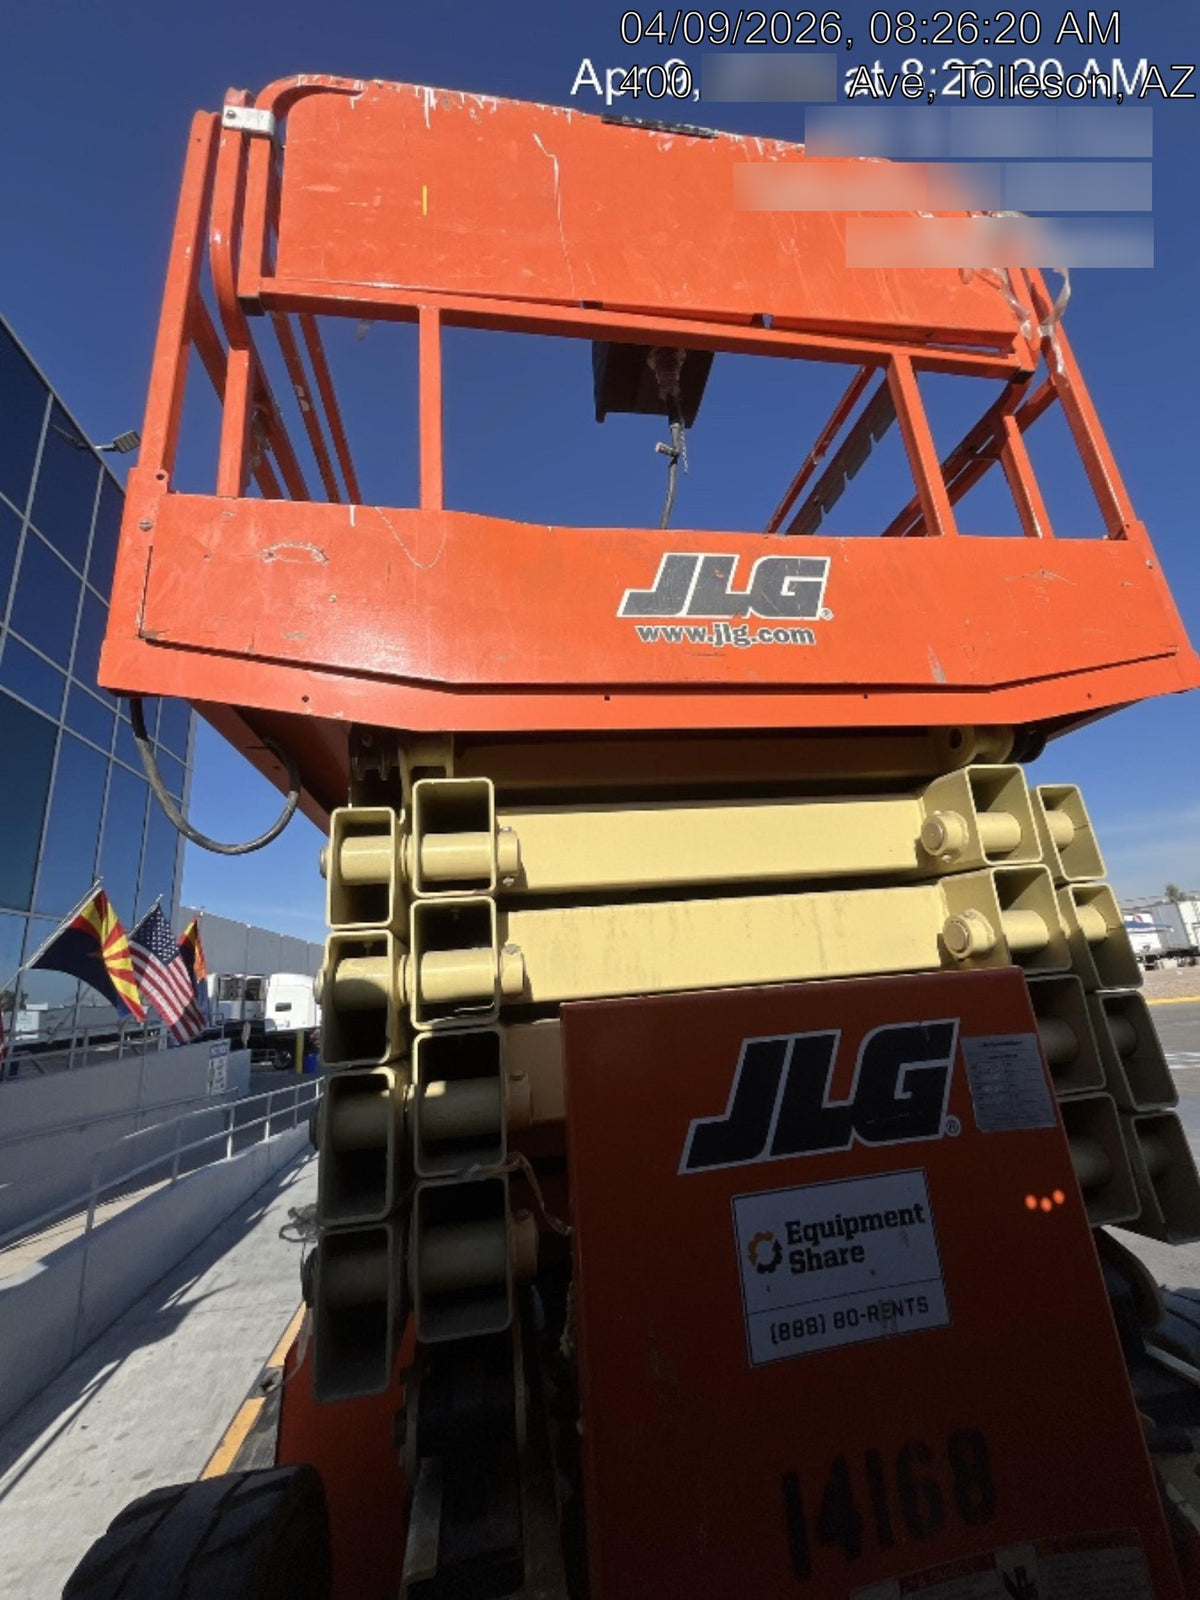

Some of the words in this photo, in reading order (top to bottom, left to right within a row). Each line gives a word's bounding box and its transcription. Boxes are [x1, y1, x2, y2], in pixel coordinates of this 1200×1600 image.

[616, 552, 831, 621] JLG
[635, 622, 816, 647] www.jlg.com
[677, 1017, 960, 1176] JLG
[785, 1203, 925, 1246] Equipment
[789, 1244, 865, 1274] Share
[770, 1314, 825, 1345] (888)
[834, 1296, 929, 1329] 80-RENTS
[781, 1426, 997, 1580] 14168
